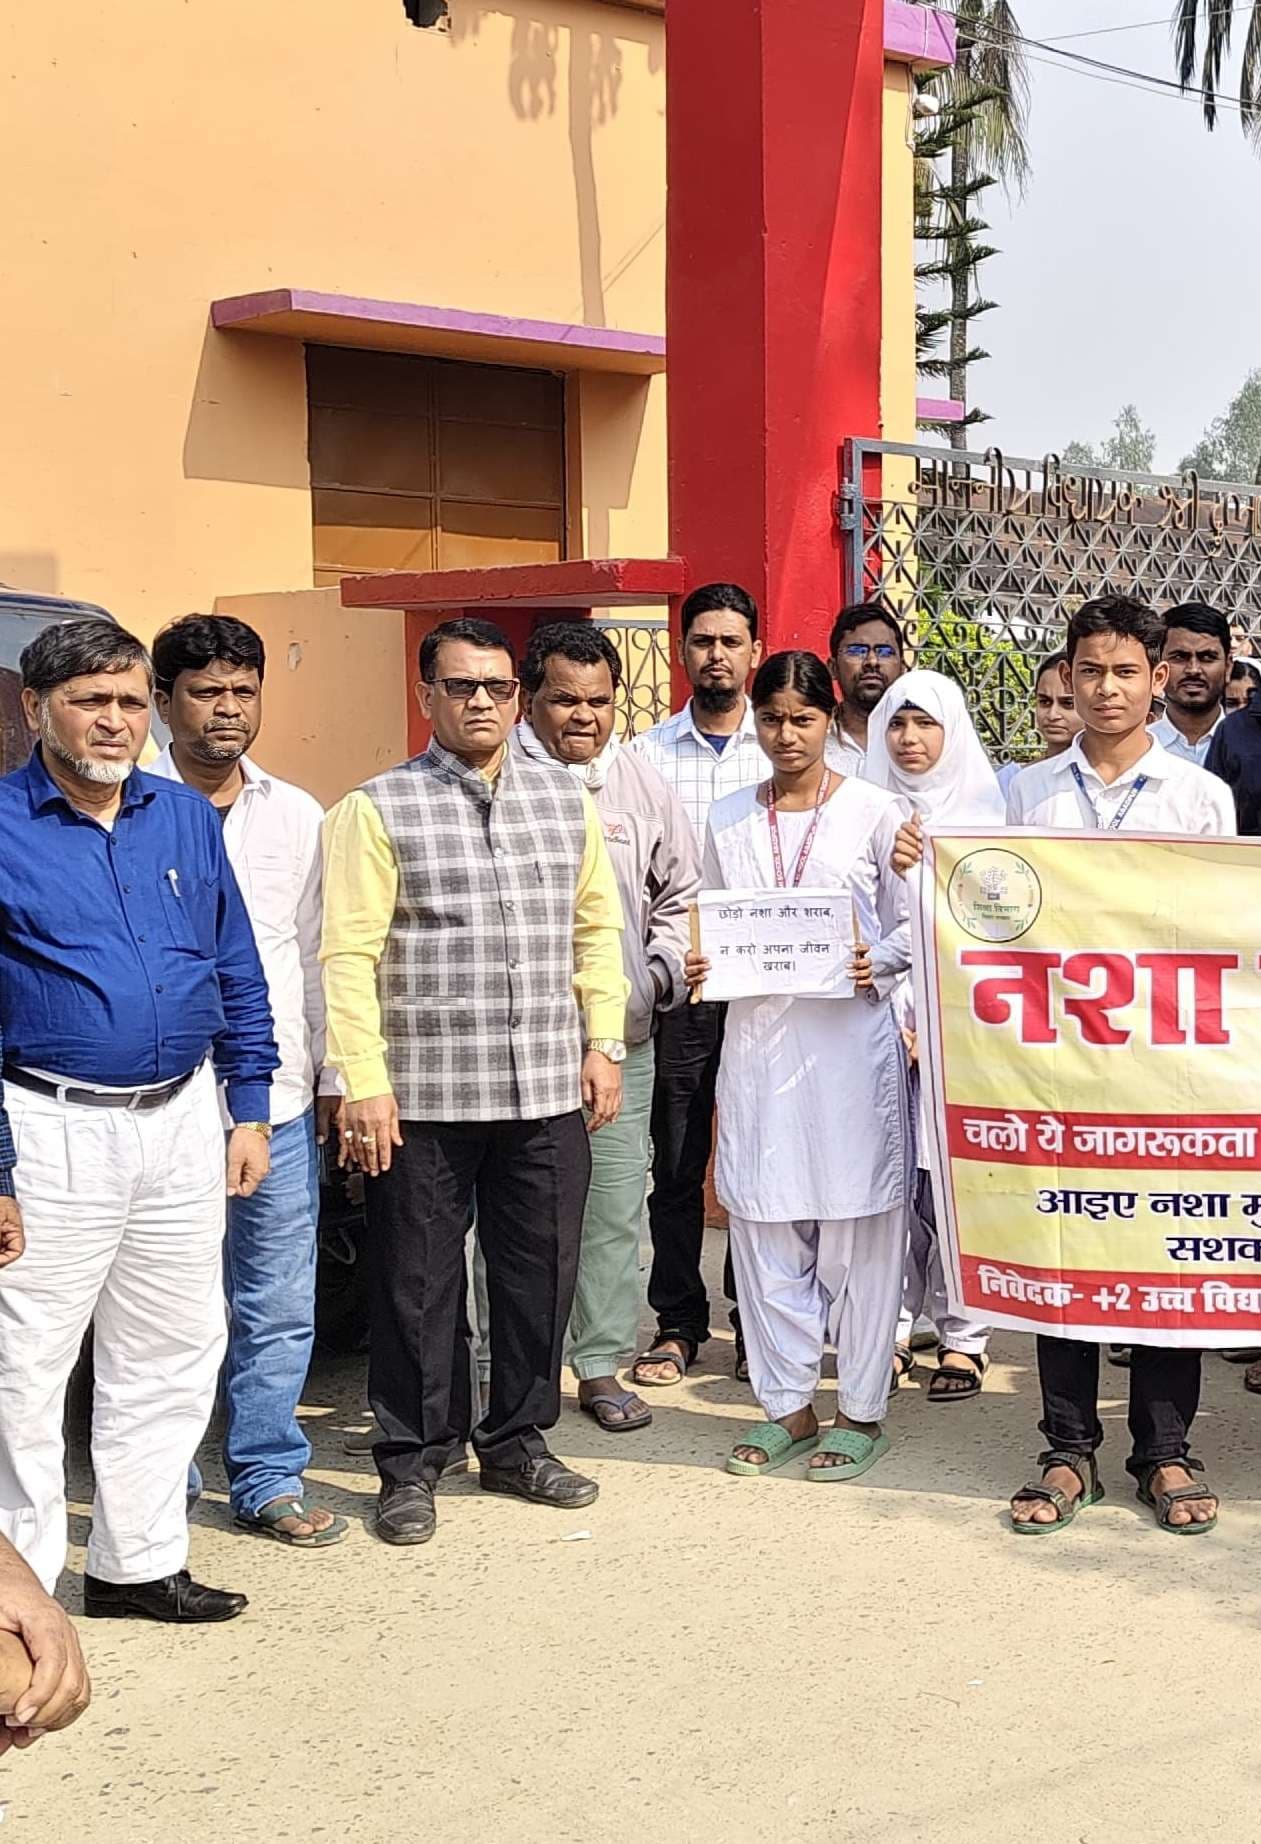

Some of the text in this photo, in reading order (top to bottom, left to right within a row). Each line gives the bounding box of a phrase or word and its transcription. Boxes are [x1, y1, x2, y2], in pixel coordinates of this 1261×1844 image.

[749, 907, 773, 919] नशा
[778, 905, 798, 919] और
[803, 907, 834, 919] शराब,
[719, 941, 831, 956] न करो अपना जीवन
[762, 961, 796, 972] खराब।
[961, 949, 1238, 1045] नशा
[962, 1114, 1028, 1152] चलो
[1036, 1115, 1065, 1154] ये
[1073, 1126, 1258, 1158] जागरूकता
[1036, 1188, 1138, 1219] आइए
[1149, 1192, 1230, 1218] नशा
[978, 1265, 1083, 1307] निवेदक-
[1092, 1283, 1131, 1312] +2
[1138, 1285, 1195, 1313] उच्च
